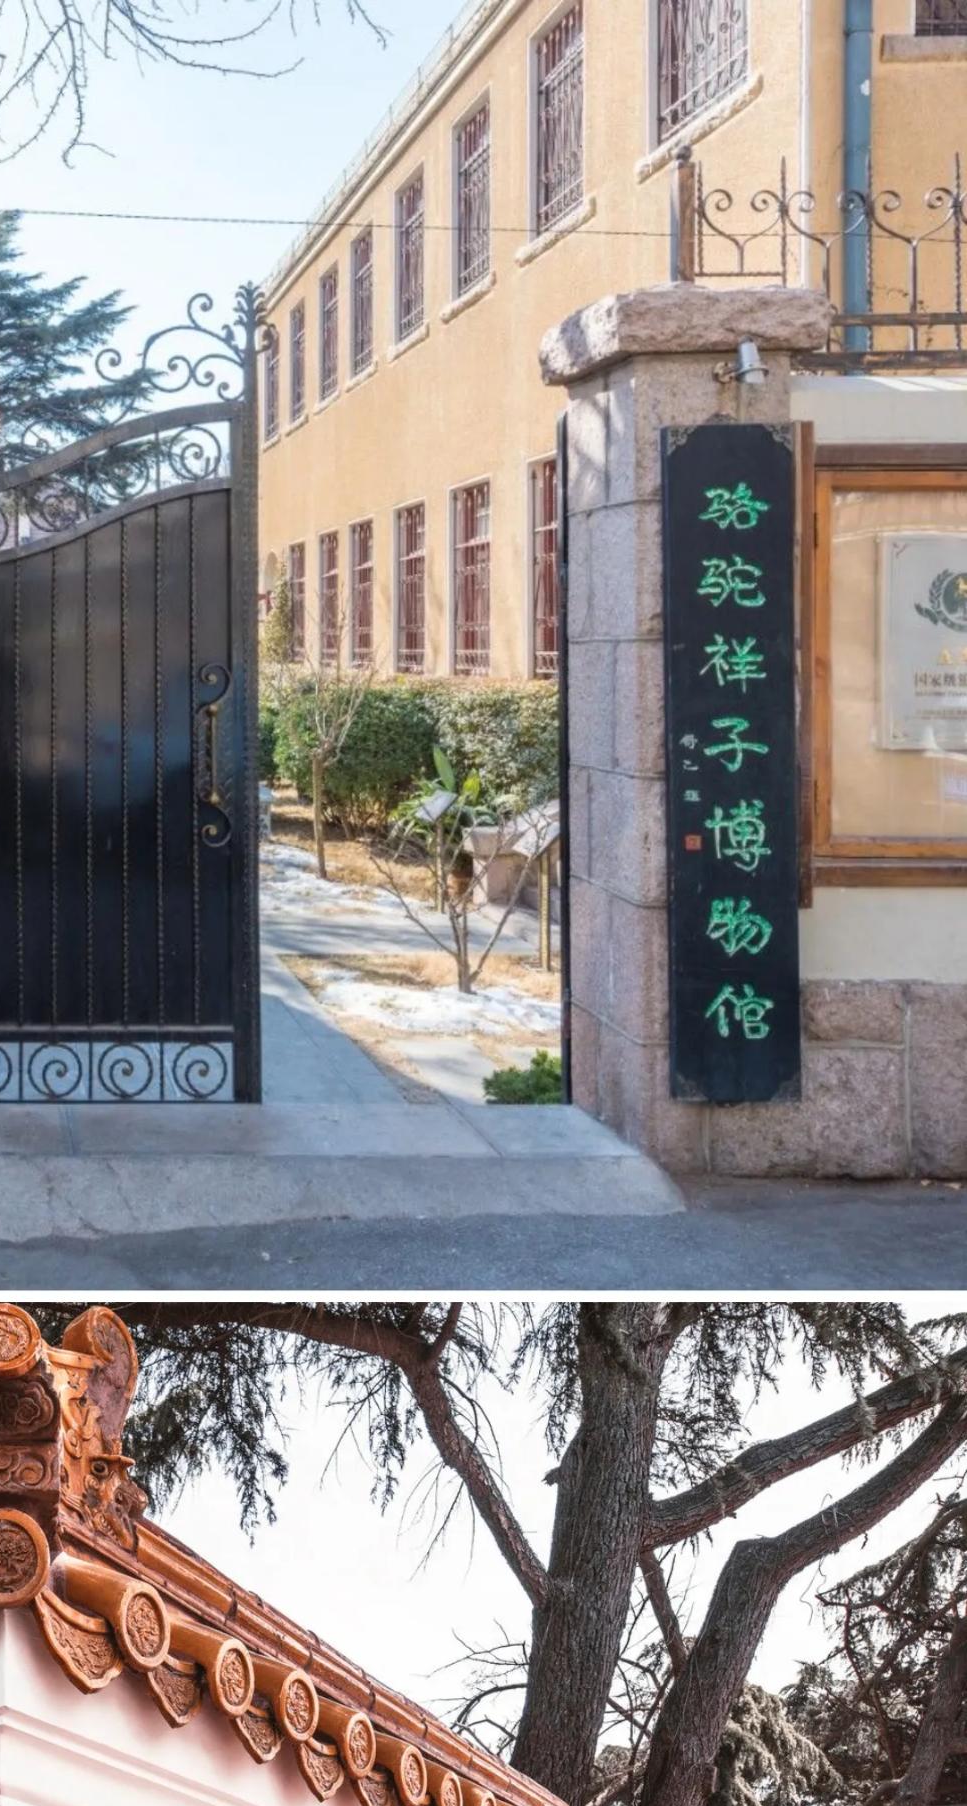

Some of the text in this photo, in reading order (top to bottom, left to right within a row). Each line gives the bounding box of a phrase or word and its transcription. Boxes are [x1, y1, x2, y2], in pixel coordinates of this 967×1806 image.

[697, 482, 774, 1042] 骆驼祥子博物馆
